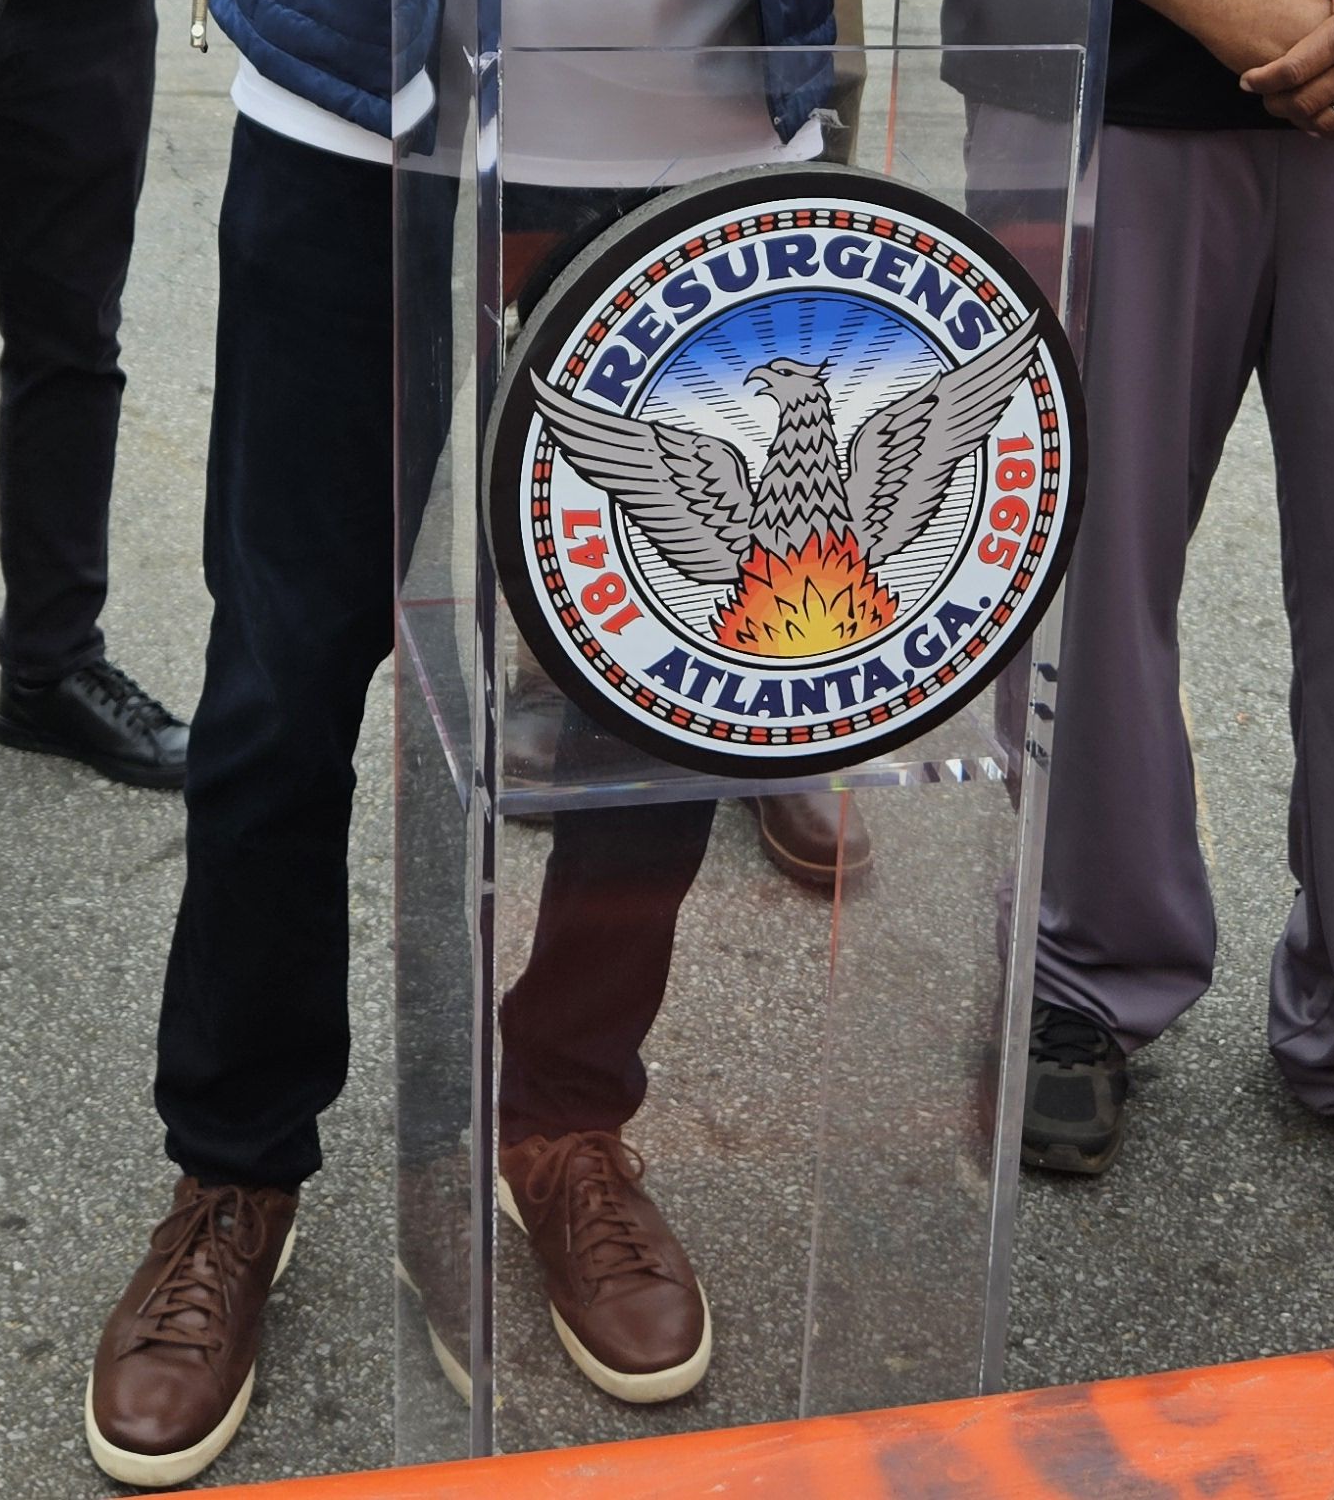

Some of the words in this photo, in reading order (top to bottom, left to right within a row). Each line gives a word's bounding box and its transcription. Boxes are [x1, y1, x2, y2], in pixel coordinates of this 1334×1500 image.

[584, 232, 995, 408] RESURGENS
[560, 507, 646, 636] 1847
[976, 430, 1038, 572] 1865
